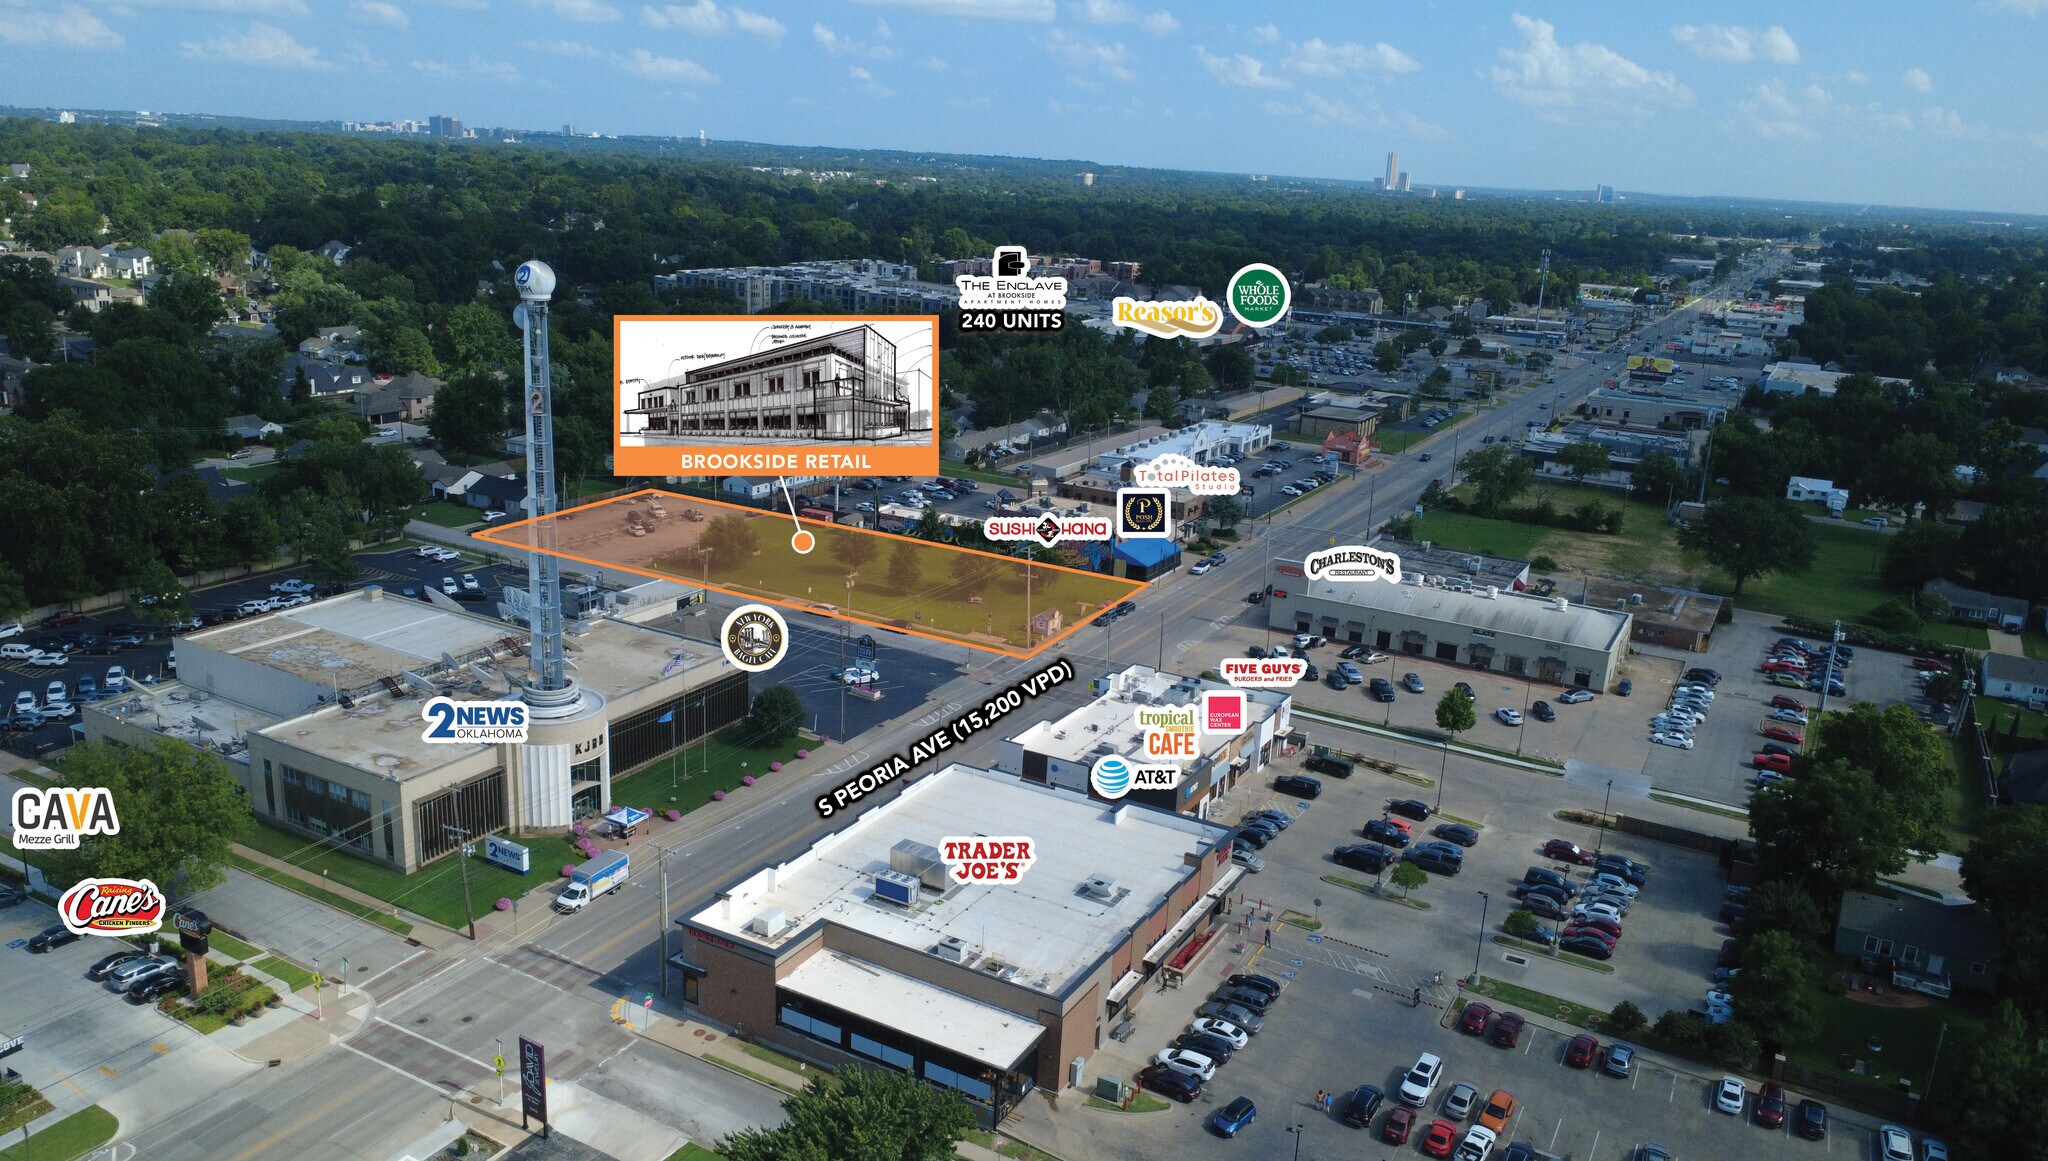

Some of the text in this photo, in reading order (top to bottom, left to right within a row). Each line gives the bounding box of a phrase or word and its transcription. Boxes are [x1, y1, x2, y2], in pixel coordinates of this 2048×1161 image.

[530, 390, 545, 414] 2
[488, 841, 521, 861] 2 NEWS
